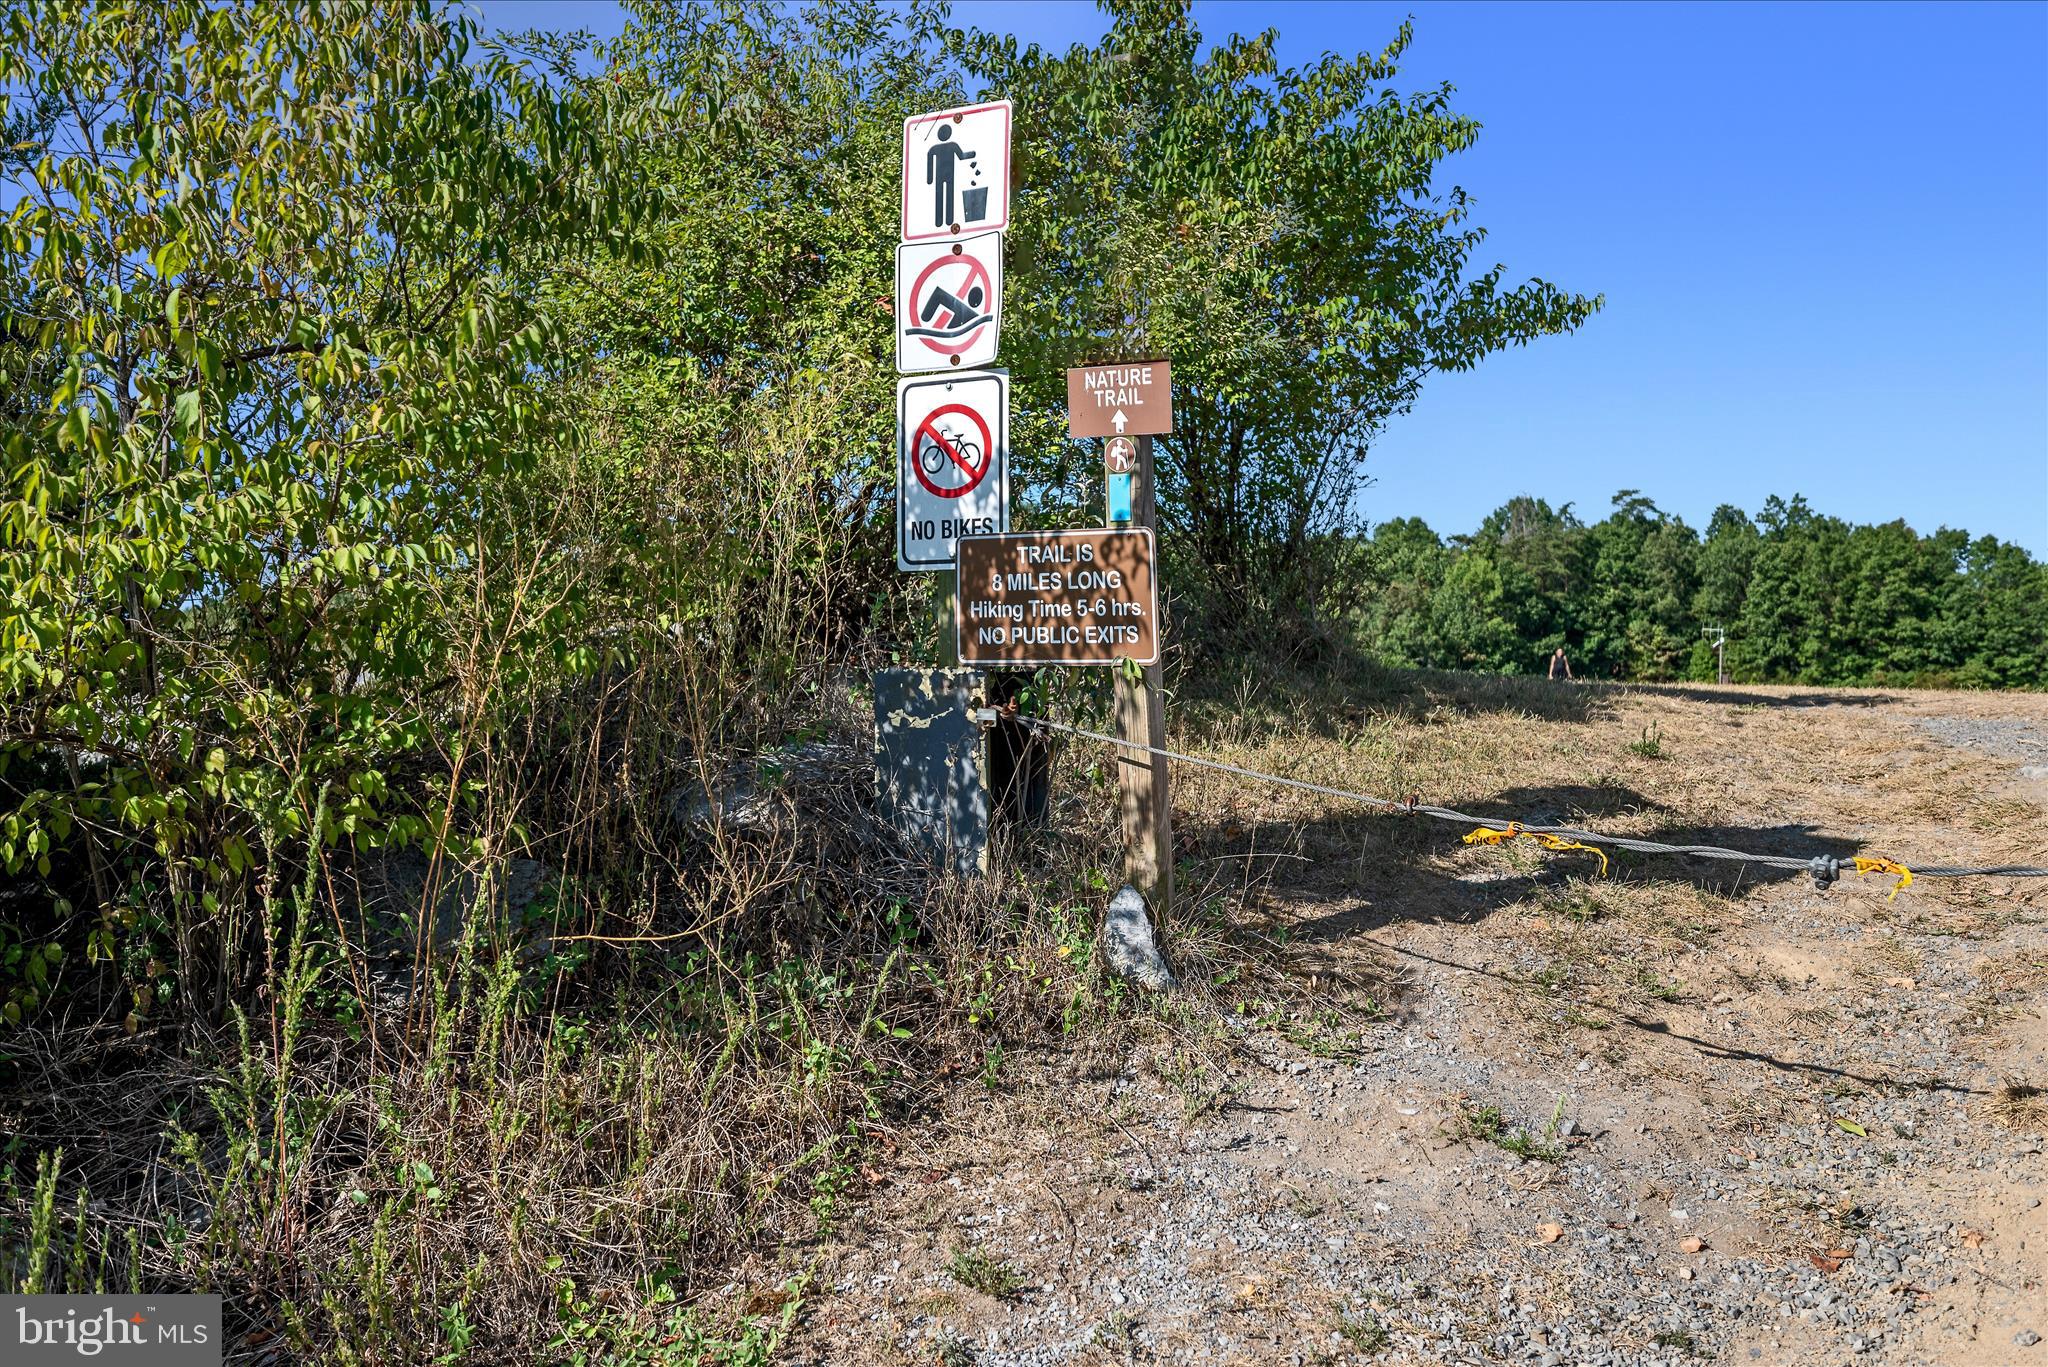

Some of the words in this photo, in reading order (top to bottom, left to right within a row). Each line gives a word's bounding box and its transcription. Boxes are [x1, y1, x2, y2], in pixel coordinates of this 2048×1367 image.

[1084, 367, 1152, 388] NATURE
[1094, 387, 1144, 407] TRAIL
[911, 520, 935, 541] NO
[942, 517, 994, 539] BIKES
[1016, 544, 1071, 564] TRAIL
[1076, 543, 1094, 562] IS
[992, 573, 1003, 592] 8
[1007, 571, 1062, 591] MILES
[1067, 570, 1121, 590] LONG
[970, 600, 1024, 622] Hiking
[1028, 599, 1072, 618] Time
[1077, 598, 1107, 617] 5-6
[1111, 598, 1146, 617] hrs.
[979, 627, 1006, 646] NO
[1011, 625, 1080, 645] PUBLIC
[1085, 625, 1139, 644] EXITS
